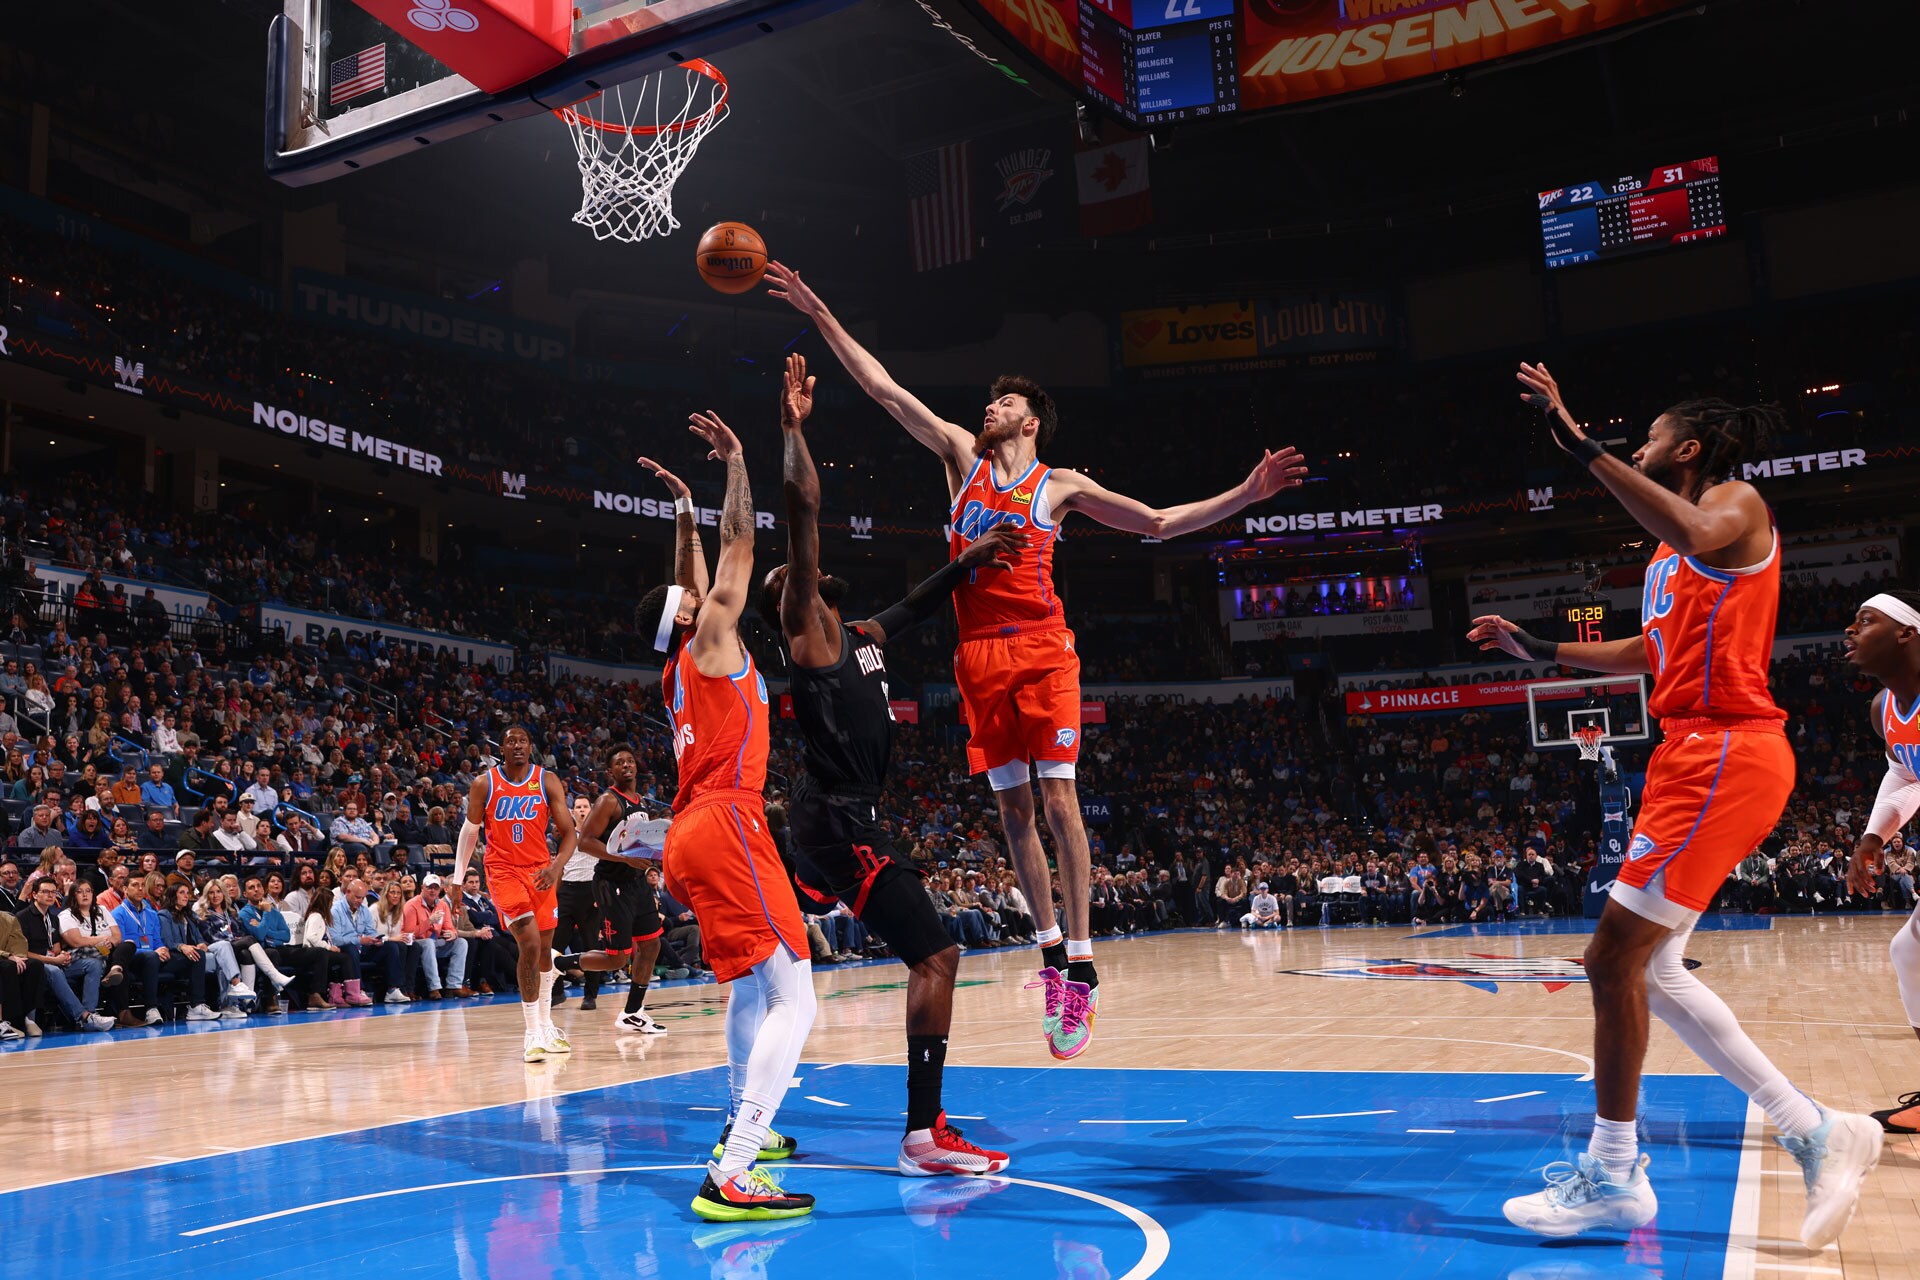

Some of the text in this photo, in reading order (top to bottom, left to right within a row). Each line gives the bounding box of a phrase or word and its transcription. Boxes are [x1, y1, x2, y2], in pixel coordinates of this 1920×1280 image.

[1136, 20, 1233, 42] PLAYER PTS FL
[1137, 46, 1154, 55] DORT
[1226, 33, 1232, 41] 0
[1137, 47, 1232, 69] HOLMGREN 2 1
[1138, 71, 1170, 82] WILLIAMS
[1217, 63, 1222, 71] 5
[1139, 88, 1152, 96] JOE
[1140, 99, 1172, 110] WILLIAMS
[1231, 88, 1235, 96] 1
[1146, 103, 1236, 123] TO 6 TF 0 2ND 10:28
[994, 148, 1052, 178] THUNDER
[1618, 175, 1633, 183] 2ND
[1662, 167, 1683, 184] 31
[1539, 180, 1642, 209] OKC 22 10:28
[1629, 198, 1655, 207] HOLIDAY
[1543, 223, 1574, 232] HOLMGREN
[1632, 216, 1649, 224] SMITH
[1632, 222, 1659, 232] BULLOCK
[1544, 231, 1571, 240] WILLIAMS
[1633, 232, 1653, 240] GREEN
[1546, 248, 1573, 257] WILLIAMS
[1573, 255, 1581, 263] TF
[706, 256, 754, 271] Wilson
[297, 283, 565, 362] THUNDER UP
[1262, 300, 1386, 349] LOUD CITY
[1189, 364, 1216, 375] THE
[1221, 359, 1288, 372] THUNDER
[1309, 353, 1341, 365] EXIT
[1344, 351, 1376, 362] NOW
[253, 401, 443, 477] NOISE METER
[1742, 448, 1868, 480] METER
[593, 490, 676, 520] NOISE
[1245, 503, 1443, 534] NOISE METER
[1533, 599, 1553, 610] POST
[1362, 613, 1409, 625] POST OAK
[1567, 606, 1604, 623] 10:28
[1257, 620, 1302, 632] POST OAK
[1370, 625, 1402, 633] TOYOTA
[1577, 620, 1603, 643] 16
[1478, 685, 1499, 695] YOUR
[1380, 690, 1459, 708] PINNACLE
[494, 795, 542, 821] OKC
[1082, 805, 1110, 816] TRA
[512, 823, 524, 843] 8
[1608, 838, 1621, 853] OU
[1601, 852, 1627, 864] Healt
